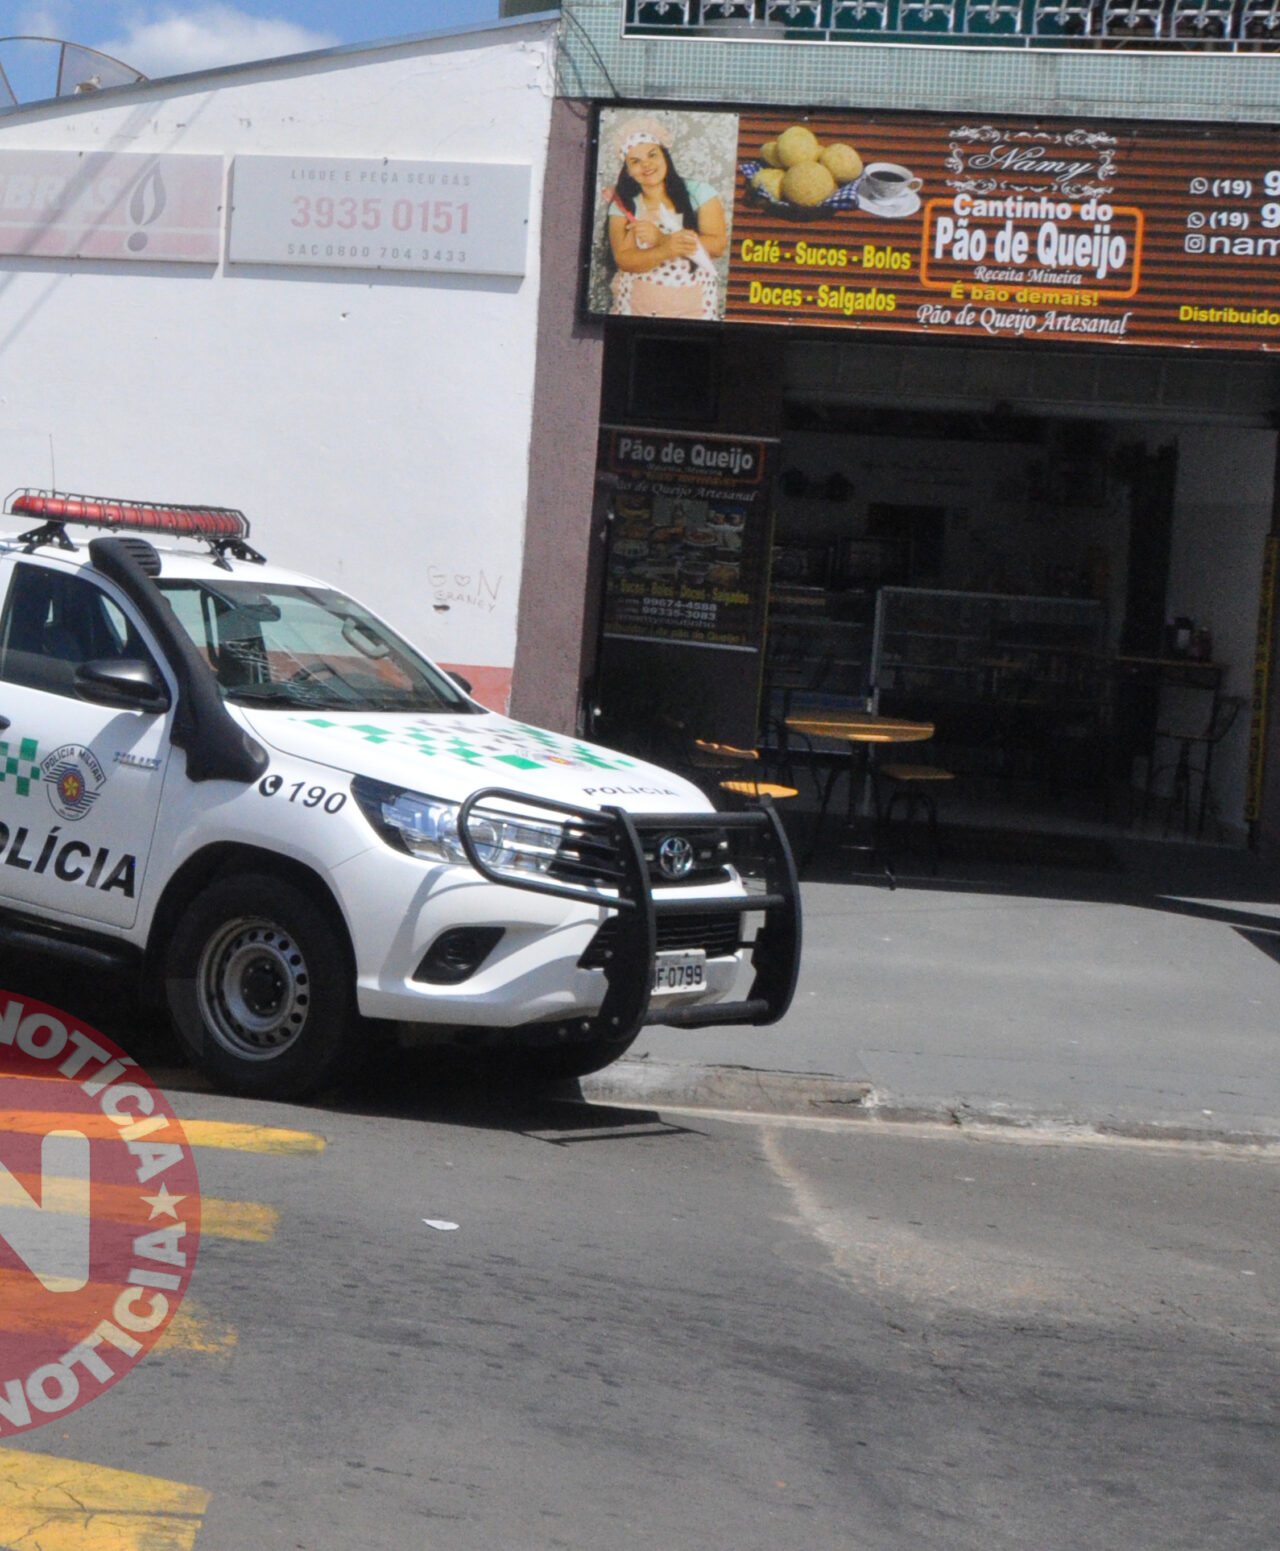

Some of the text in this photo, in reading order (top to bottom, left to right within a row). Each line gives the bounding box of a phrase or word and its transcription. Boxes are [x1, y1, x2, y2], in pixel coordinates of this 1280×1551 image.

[290, 169, 336, 181] LIGUE
[344, 170, 351, 181] E
[360, 171, 399, 184] PEÇA
[407, 172, 435, 185] SEU
[968, 145, 1095, 182] Namy
[1212, 179, 1252, 198] (19)
[290, 195, 470, 234] 3935 0151
[953, 193, 1113, 221] Cantinho do
[1209, 211, 1249, 230] (19)
[287, 243, 467, 263] SAC 0800 704 3433
[741, 239, 911, 270] Café Sucos Bolos
[934, 216, 1126, 279] Pão de Queijo
[973, 266, 1082, 285] Receita Mineira
[749, 281, 896, 315] Doces Salgados
[950, 280, 1099, 306] É bão demais!
[917, 304, 1132, 336] Pão de Queijo Artesanal
[1179, 305, 1280, 326] Distribuido
[618, 438, 656, 461] Pão
[661, 442, 686, 464] de
[691, 444, 754, 474] Queijo
[45, 747, 75, 771] POLÍCIA
[79, 749, 102, 783] MILITAR
[289, 781, 348, 814] 190
